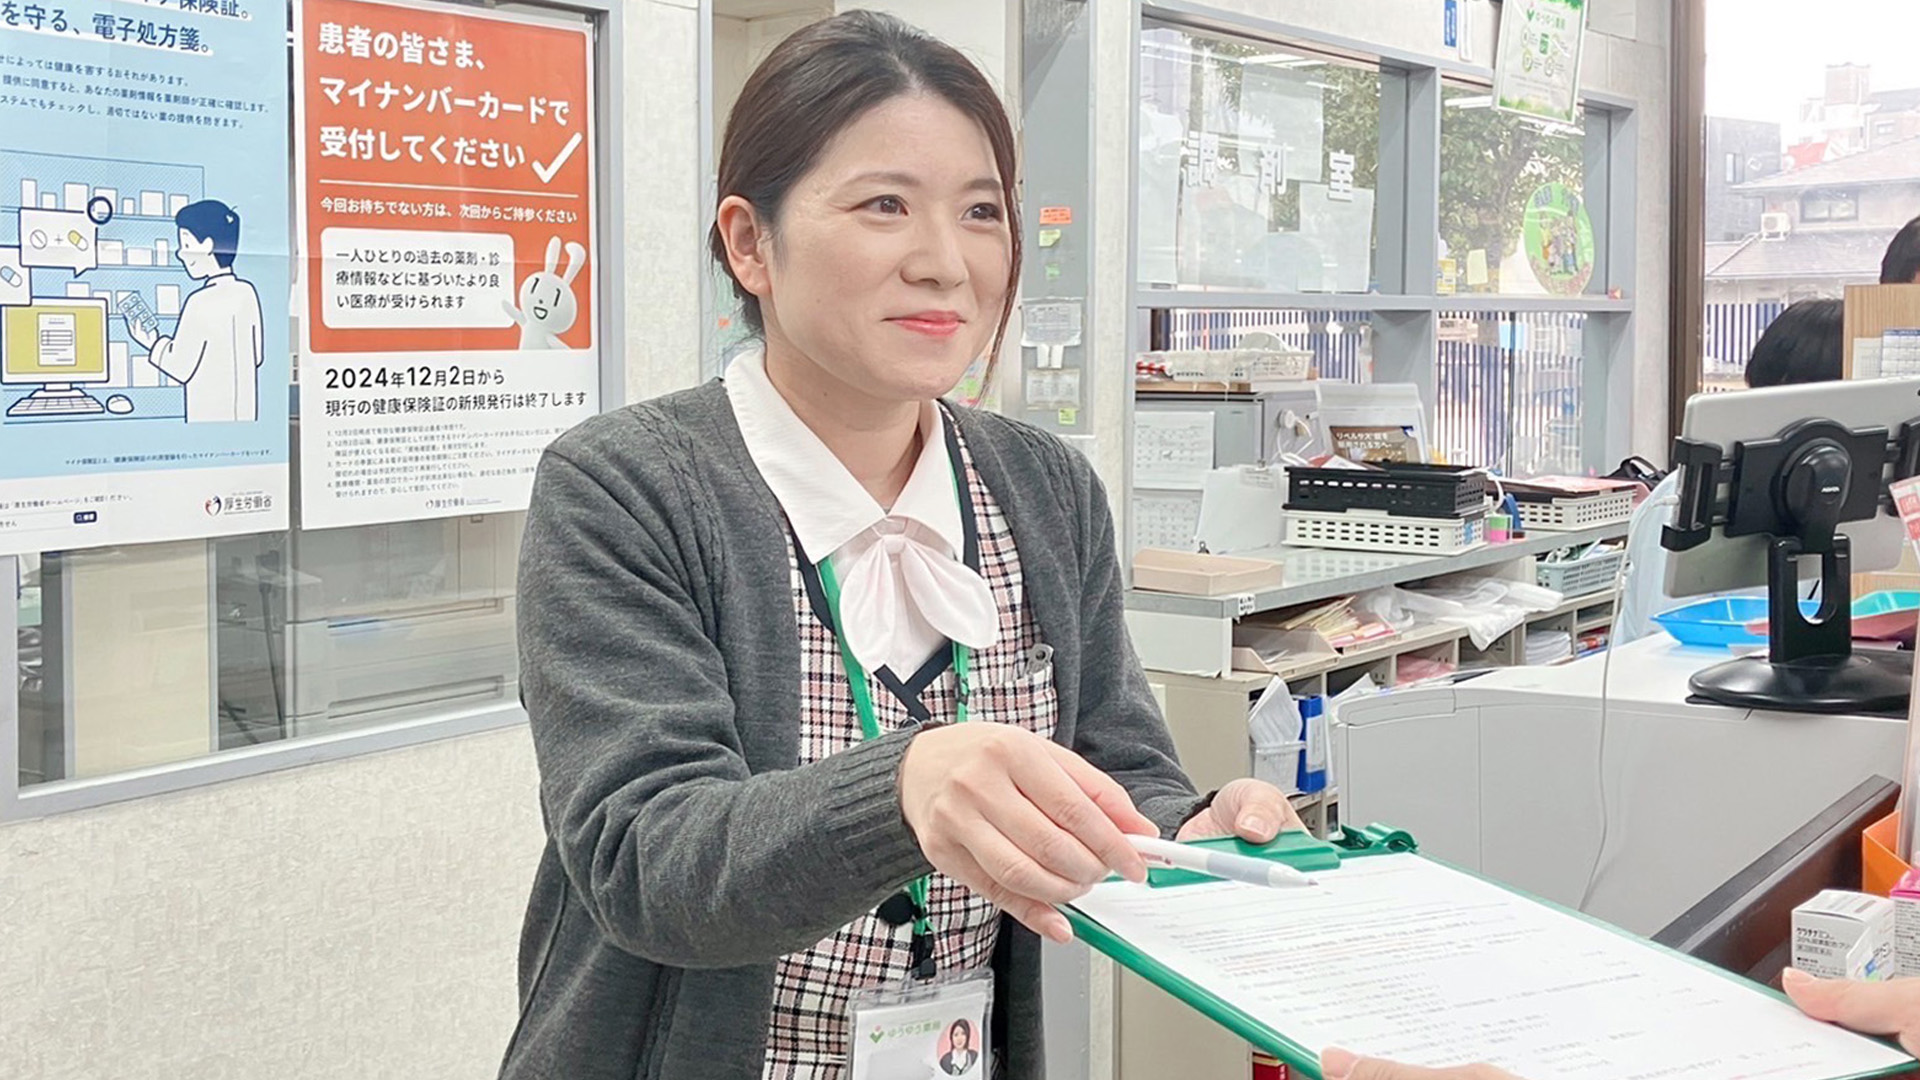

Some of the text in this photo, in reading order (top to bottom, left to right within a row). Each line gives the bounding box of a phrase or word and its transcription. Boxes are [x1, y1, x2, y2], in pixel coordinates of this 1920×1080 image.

[1, 2, 209, 53] を守る、電子処方箋。
[318, 22, 485, 70] 患者の皆さま、
[319, 77, 570, 125] マイナンバーカードで
[320, 126, 526, 168] 受付してください
[320, 197, 577, 223] 今回お持ちでない方は、次回からご持参ください
[336, 248, 500, 266] 一人ひとりの過去の薬剤・診
[336, 271, 500, 287] 療情報などに基づいたより良
[337, 294, 465, 309] い医療が受けられます
[325, 366, 505, 389] 2024年12月2日から
[325, 392, 588, 417] 現行の健康保険証の新規発行は終了します
